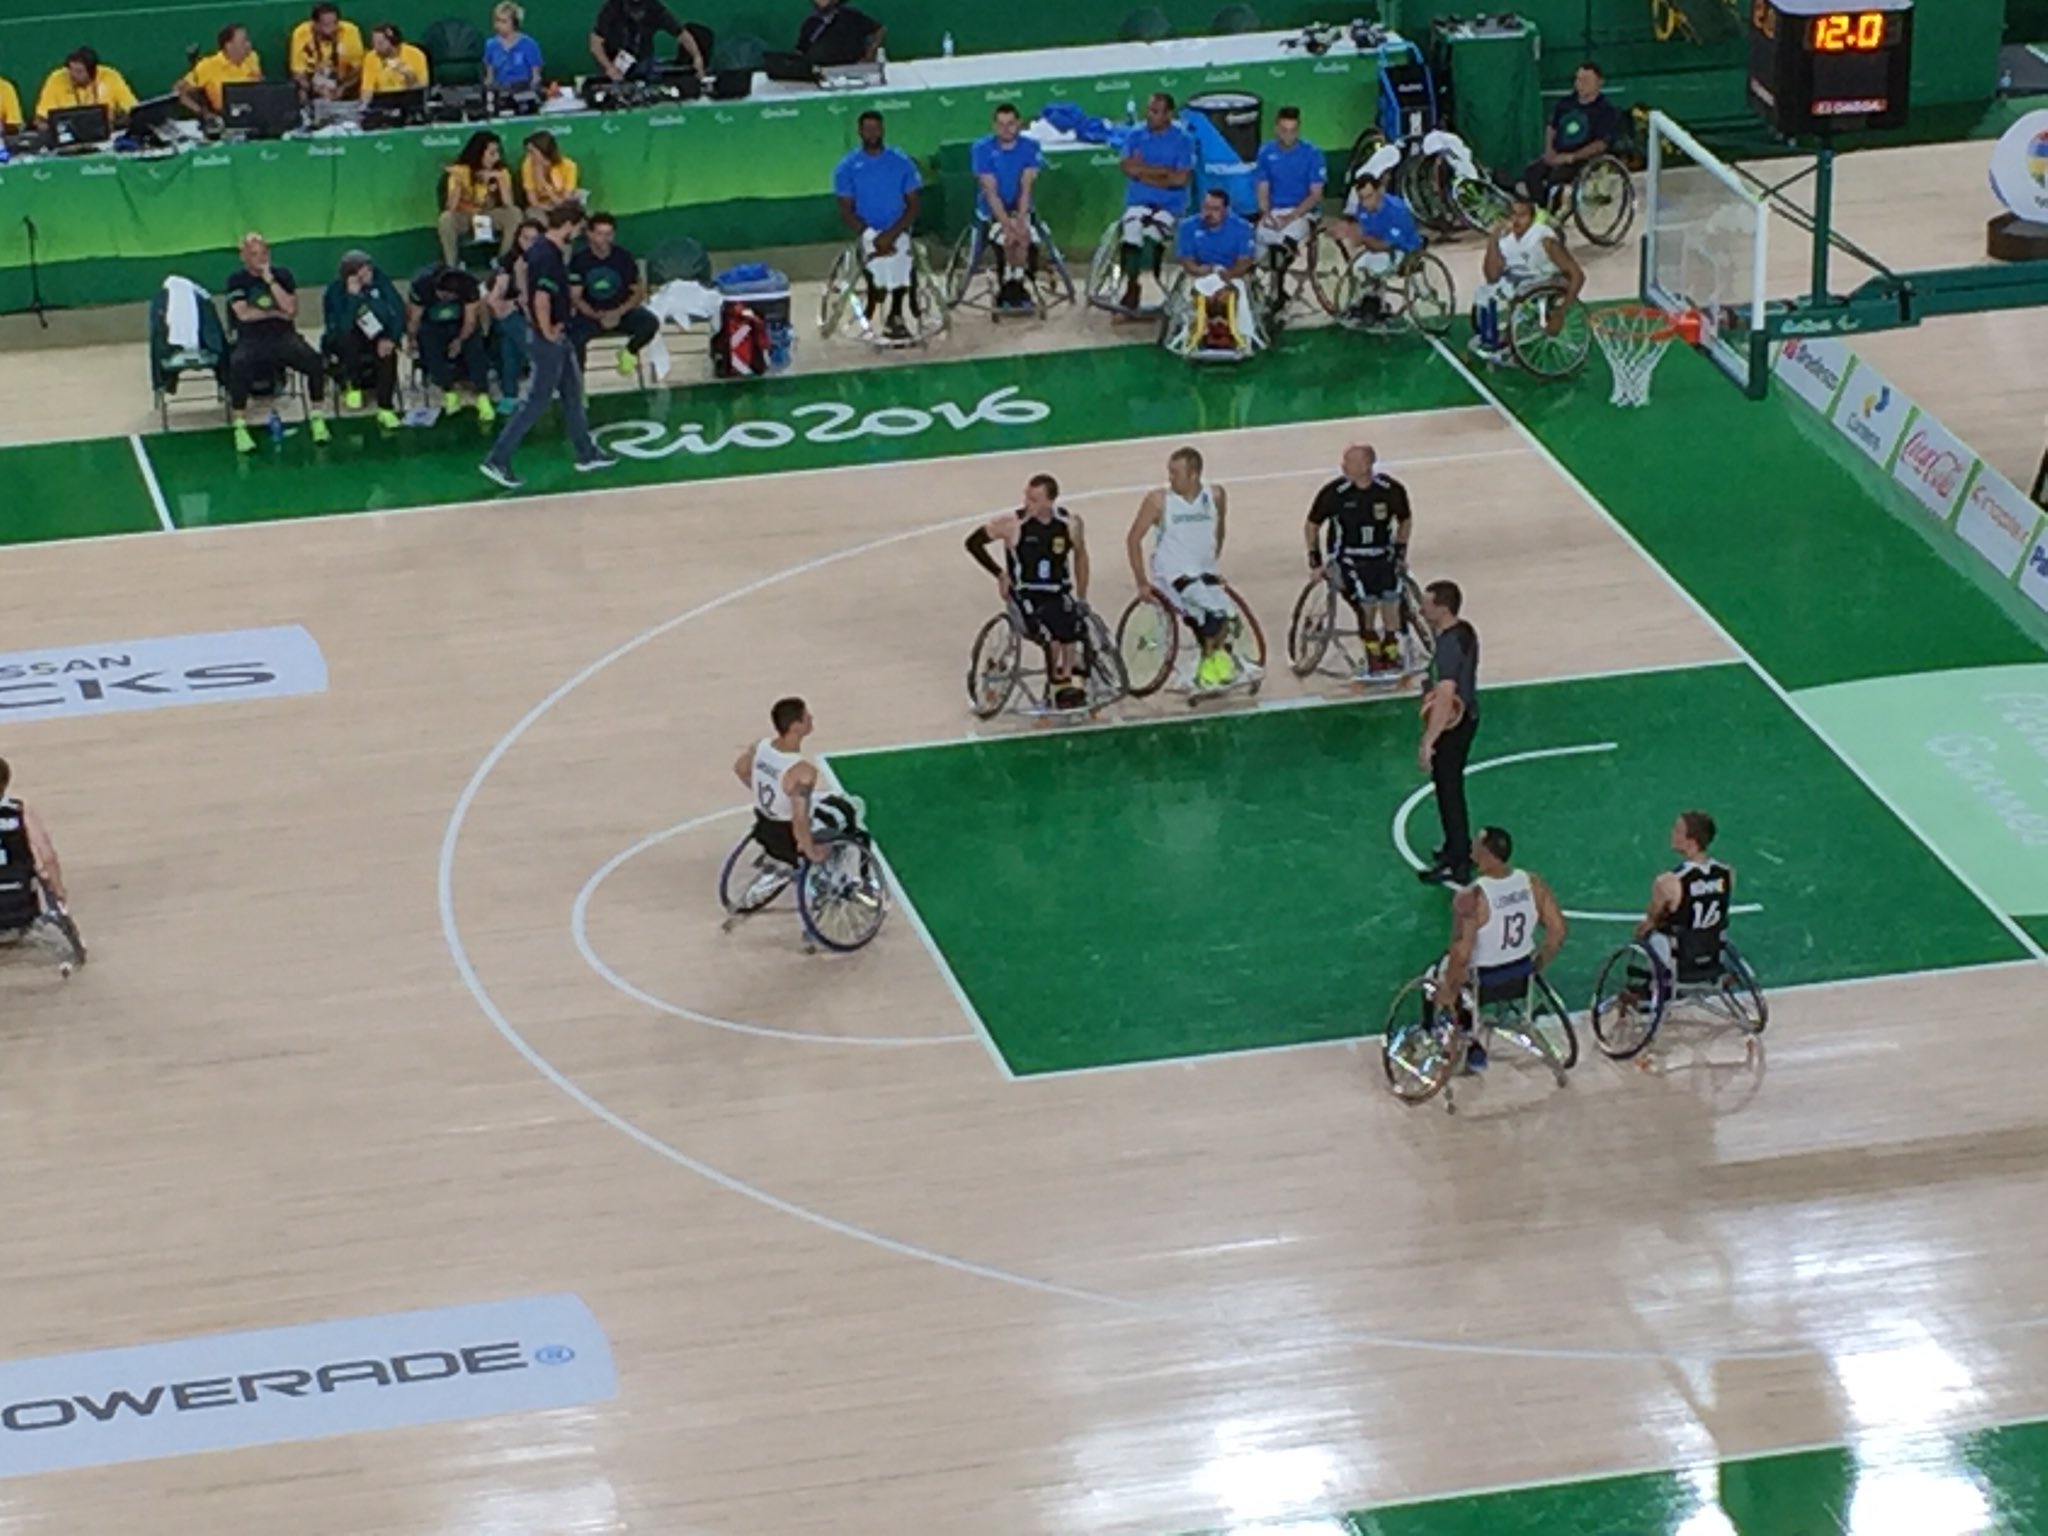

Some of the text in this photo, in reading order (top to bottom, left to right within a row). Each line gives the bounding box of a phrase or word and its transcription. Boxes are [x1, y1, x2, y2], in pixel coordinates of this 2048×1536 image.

[1815, 13, 1883, 49] 12.0
[1501, 911, 1527, 950] 13
[1692, 900, 1721, 930] 16
[2, 1342, 528, 1432] OWERADE
